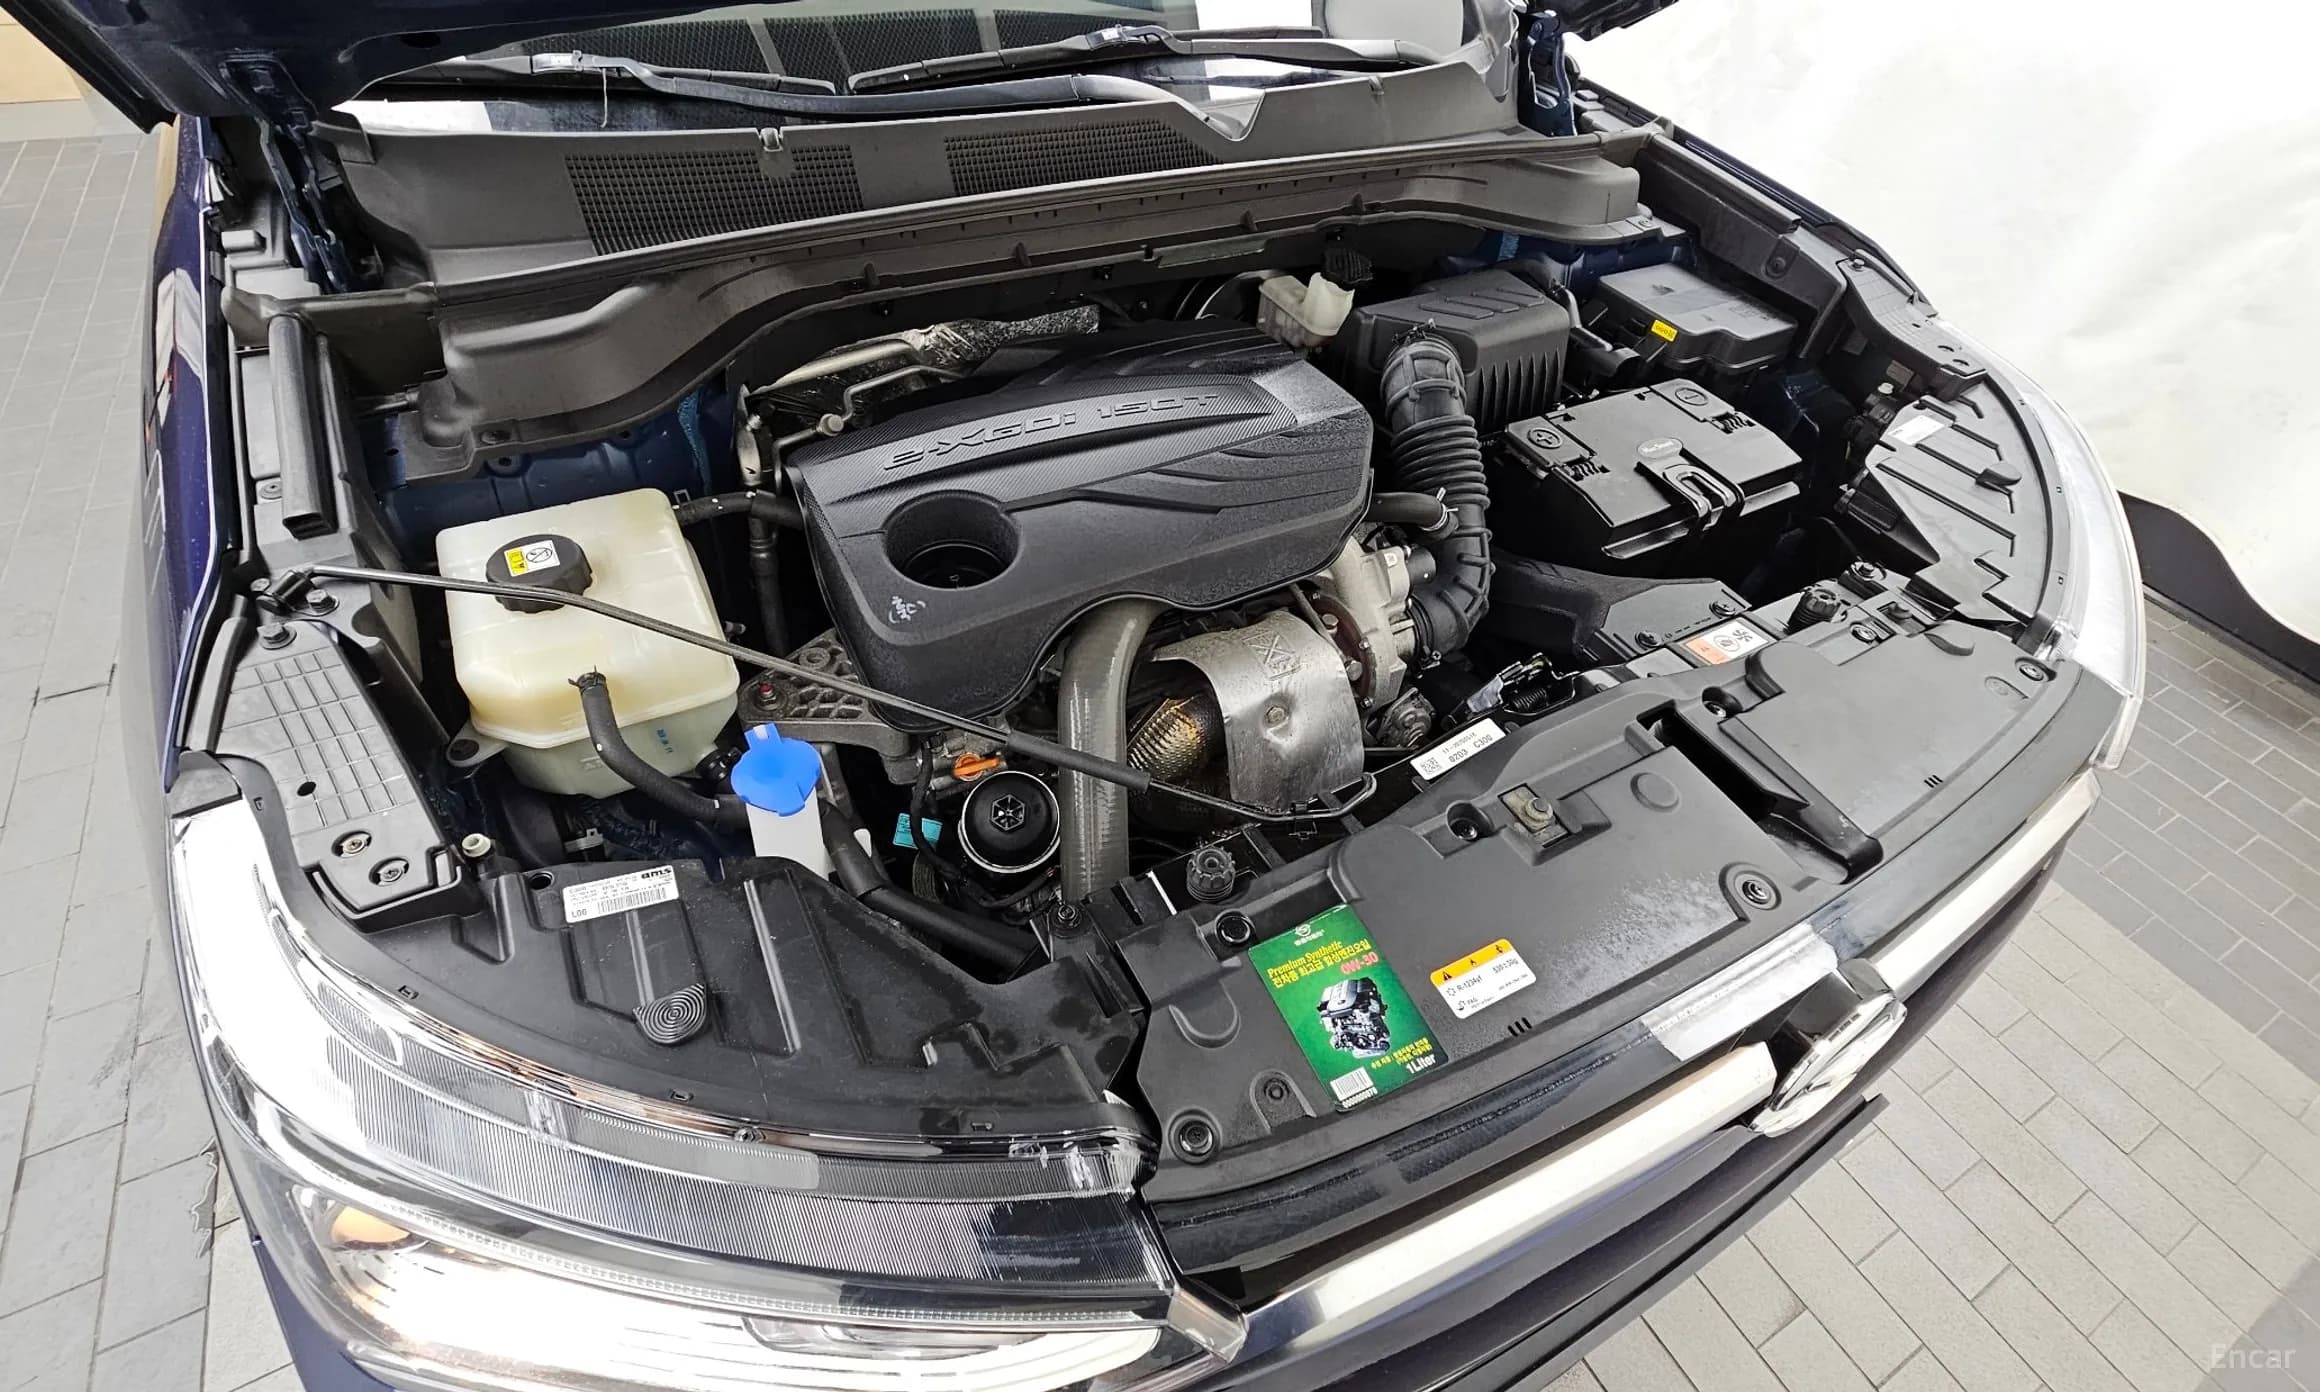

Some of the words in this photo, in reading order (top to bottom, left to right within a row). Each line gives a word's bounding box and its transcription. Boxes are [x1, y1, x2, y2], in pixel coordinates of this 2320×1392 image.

[1097, 394, 1219, 419] 150T
[641, 867, 672, 880] ams
[1267, 955, 1306, 979] Premium
[1305, 941, 1344, 962] Synthetic
[1272, 971, 1300, 989] 전차종
[1299, 958, 1325, 977] 최고급
[1323, 938, 1373, 967] 합성엔진오일
[1340, 951, 1379, 975] 0W-30
